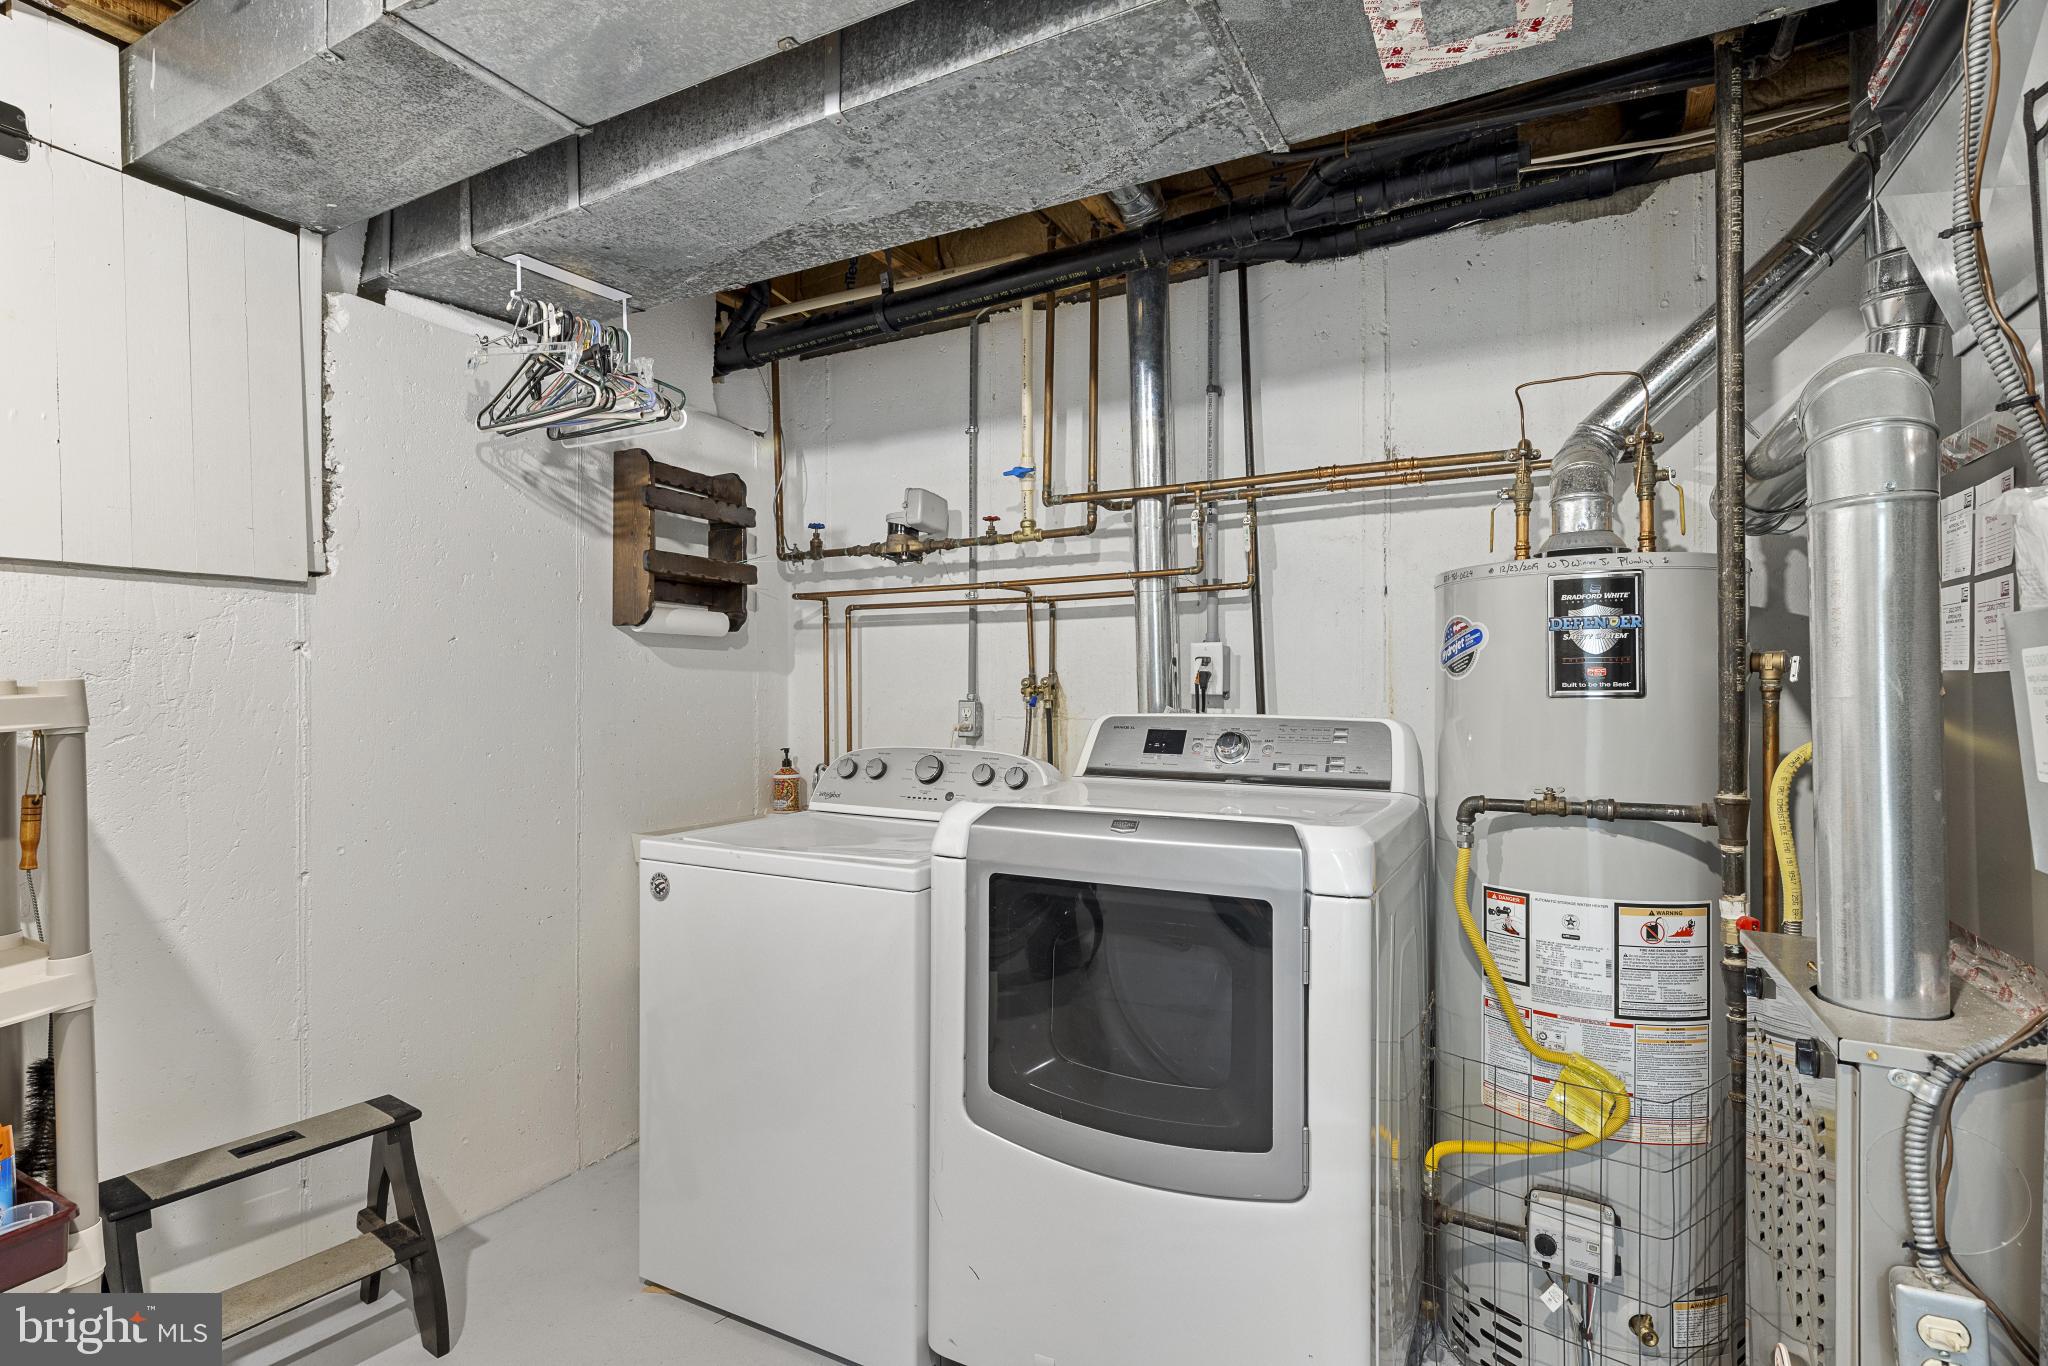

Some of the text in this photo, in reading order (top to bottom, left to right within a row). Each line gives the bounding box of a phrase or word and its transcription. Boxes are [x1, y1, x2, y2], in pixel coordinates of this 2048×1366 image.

[1561, 593, 1602, 601] BRADFORD
[1549, 614, 1644, 631] DEFENDER
[1498, 893, 1521, 903] DANGER
